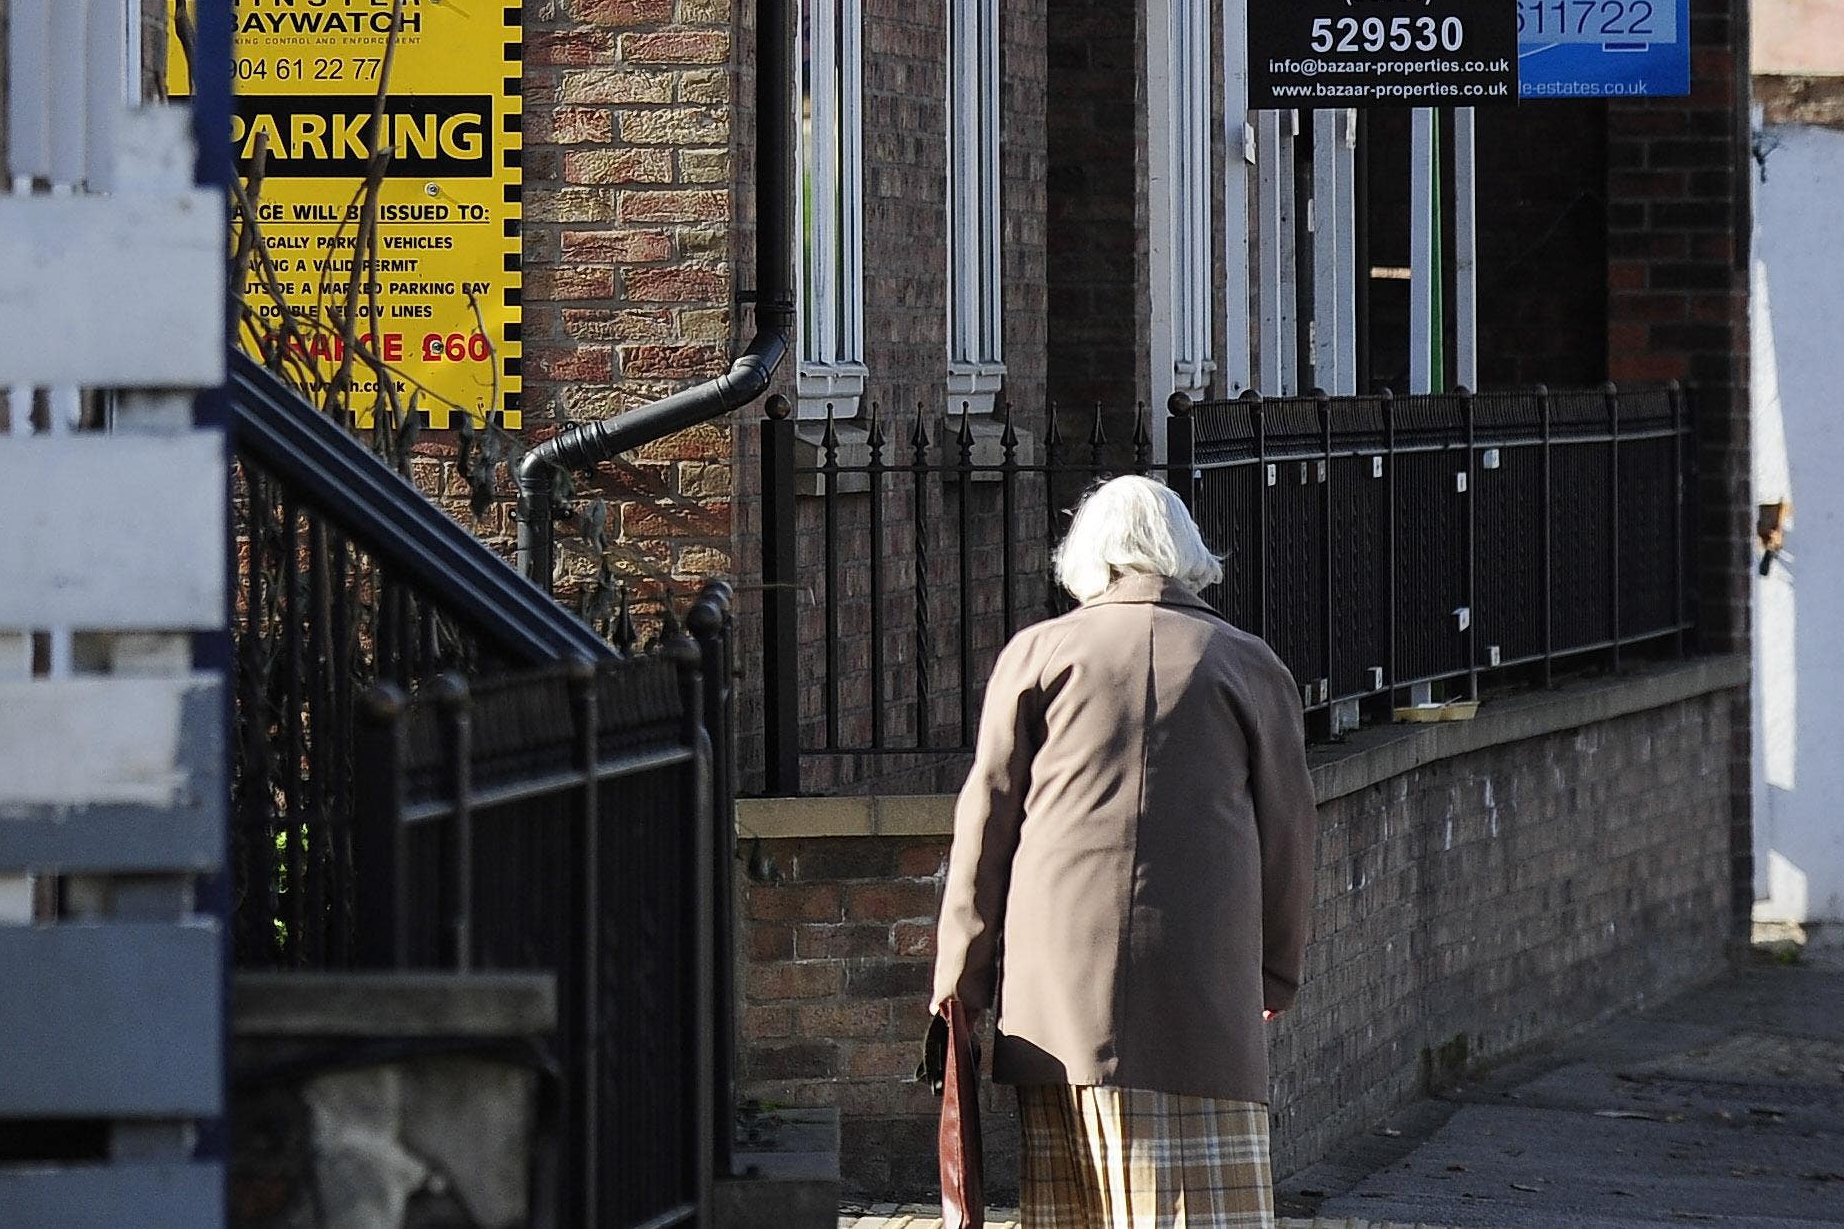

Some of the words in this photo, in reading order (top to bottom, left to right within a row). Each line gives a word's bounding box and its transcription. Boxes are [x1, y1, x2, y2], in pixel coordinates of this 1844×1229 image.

[265, 37, 310, 45] CONTROL
[316, 37, 337, 45] AND
[1311, 17, 1463, 53] 529530
[229, 58, 268, 80] 904
[275, 58, 303, 80] 61
[314, 58, 343, 80] 22
[1269, 58, 1510, 76] info@bazaar-properties.co.uk
[1271, 82, 1508, 99] www.bazaar-properties.co.uk
[1519, 79, 1647, 95] le-estates.co.uk
[293, 204, 338, 221] WILL
[380, 204, 449, 221] ISSUED
[458, 205, 491, 221] TO:
[383, 237, 453, 249] VEHICLES
[296, 260, 307, 272] A
[313, 260, 354, 272] VALID
[301, 282, 312, 295] A
[389, 282, 455, 295] PARKING
[462, 282, 491, 295] BAY
[391, 306, 432, 318] LINES
